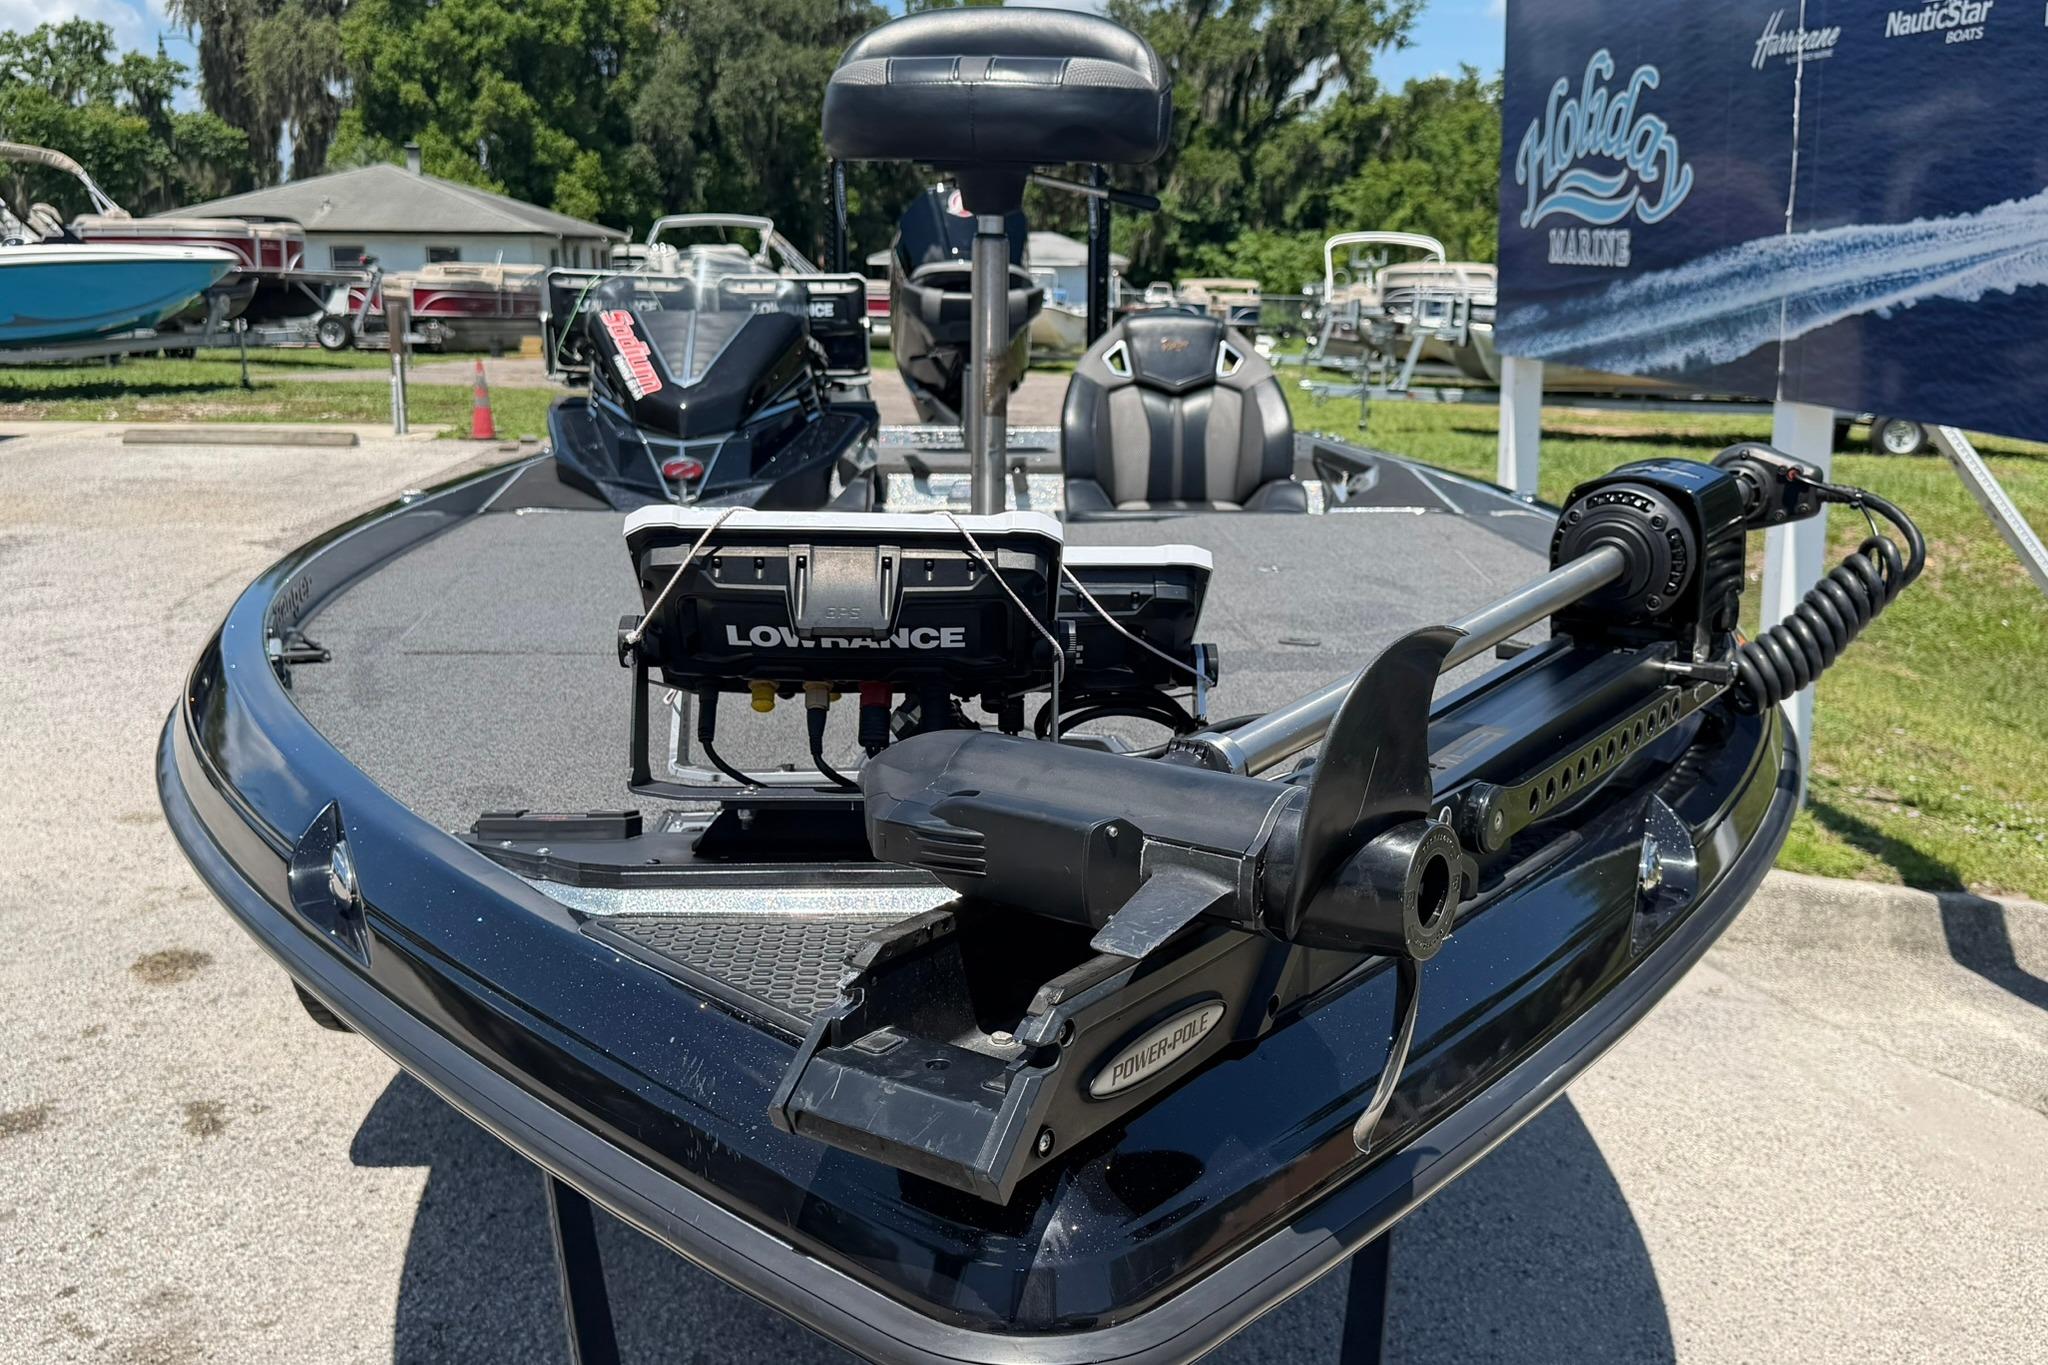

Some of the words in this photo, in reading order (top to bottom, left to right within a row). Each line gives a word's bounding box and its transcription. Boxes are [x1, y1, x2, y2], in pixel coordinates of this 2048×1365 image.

[1885, 0, 1994, 38] NauticStar
[1945, 26, 1985, 44] BOATS
[1515, 48, 1694, 229] Holiday
[1548, 228, 1631, 267] MARINE
[1111, 1011, 1209, 1088] POWER-POLE
